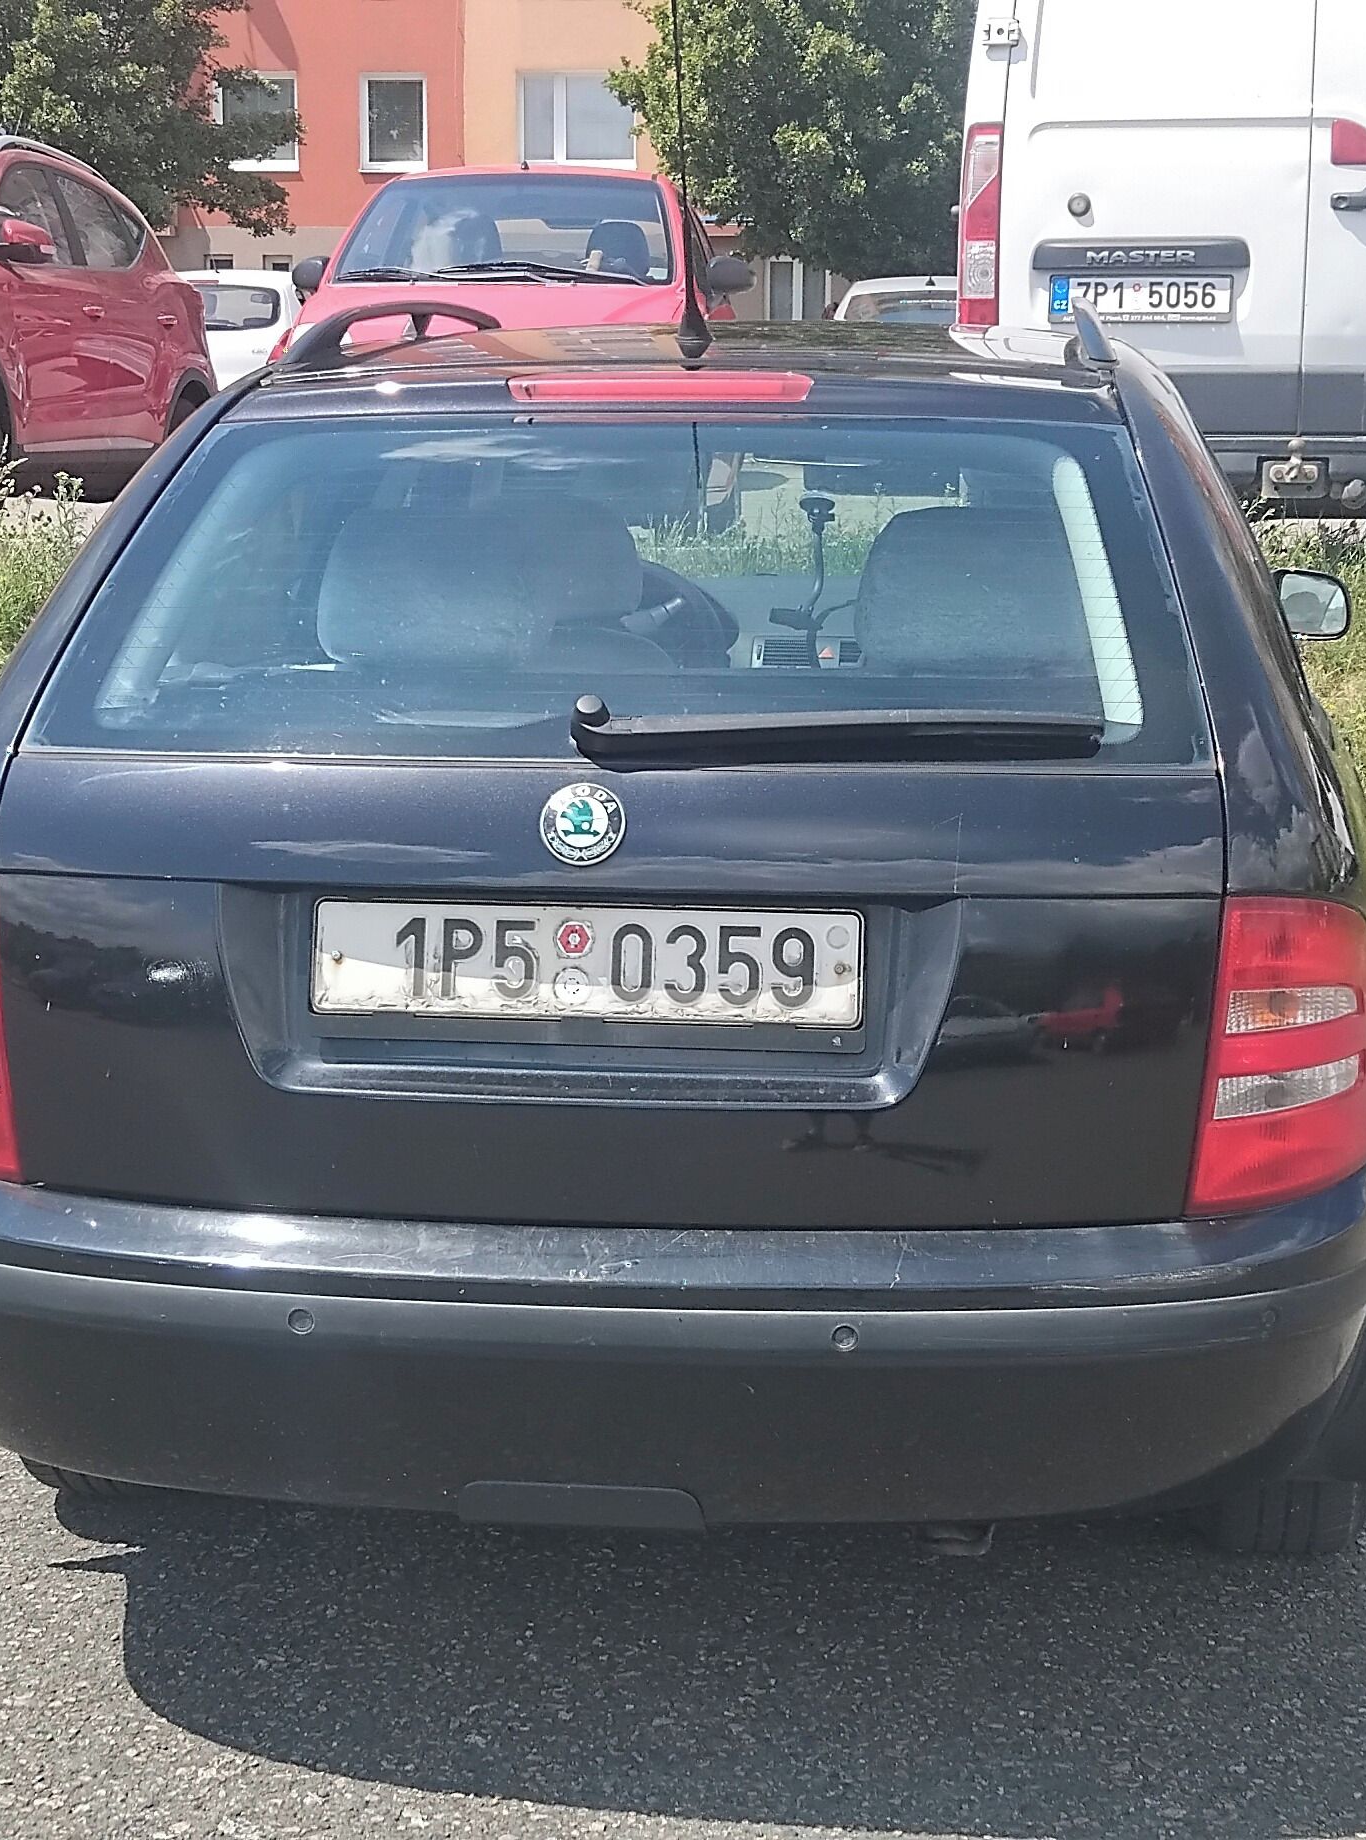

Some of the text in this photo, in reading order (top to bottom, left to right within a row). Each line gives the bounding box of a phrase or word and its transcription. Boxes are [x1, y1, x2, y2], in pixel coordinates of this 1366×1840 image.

[1086, 250, 1196, 265] MASTER
[1053, 300, 1068, 310] CZ
[1077, 281, 1217, 309] 7P1 5056
[395, 917, 817, 1008] 1P5 0359
